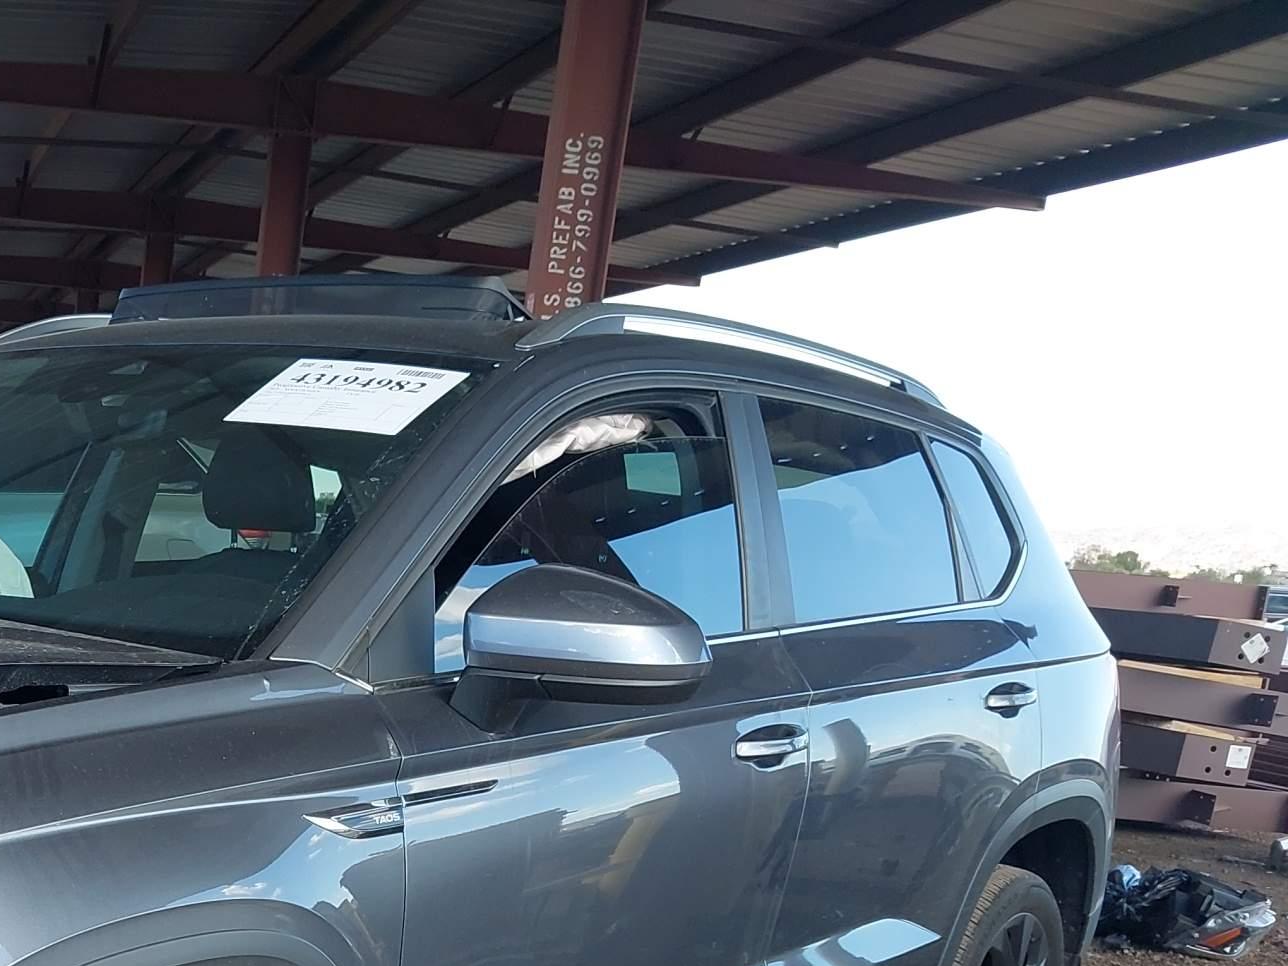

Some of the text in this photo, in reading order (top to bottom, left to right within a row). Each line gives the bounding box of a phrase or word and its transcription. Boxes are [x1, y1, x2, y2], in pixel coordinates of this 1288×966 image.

[561, 132, 585, 175] INC.
[548, 186, 575, 274] PREFAB
[564, 135, 605, 309] 866-799-0969
[290, 372, 428, 395] 43194982
[373, 812, 401, 825] TAOS
